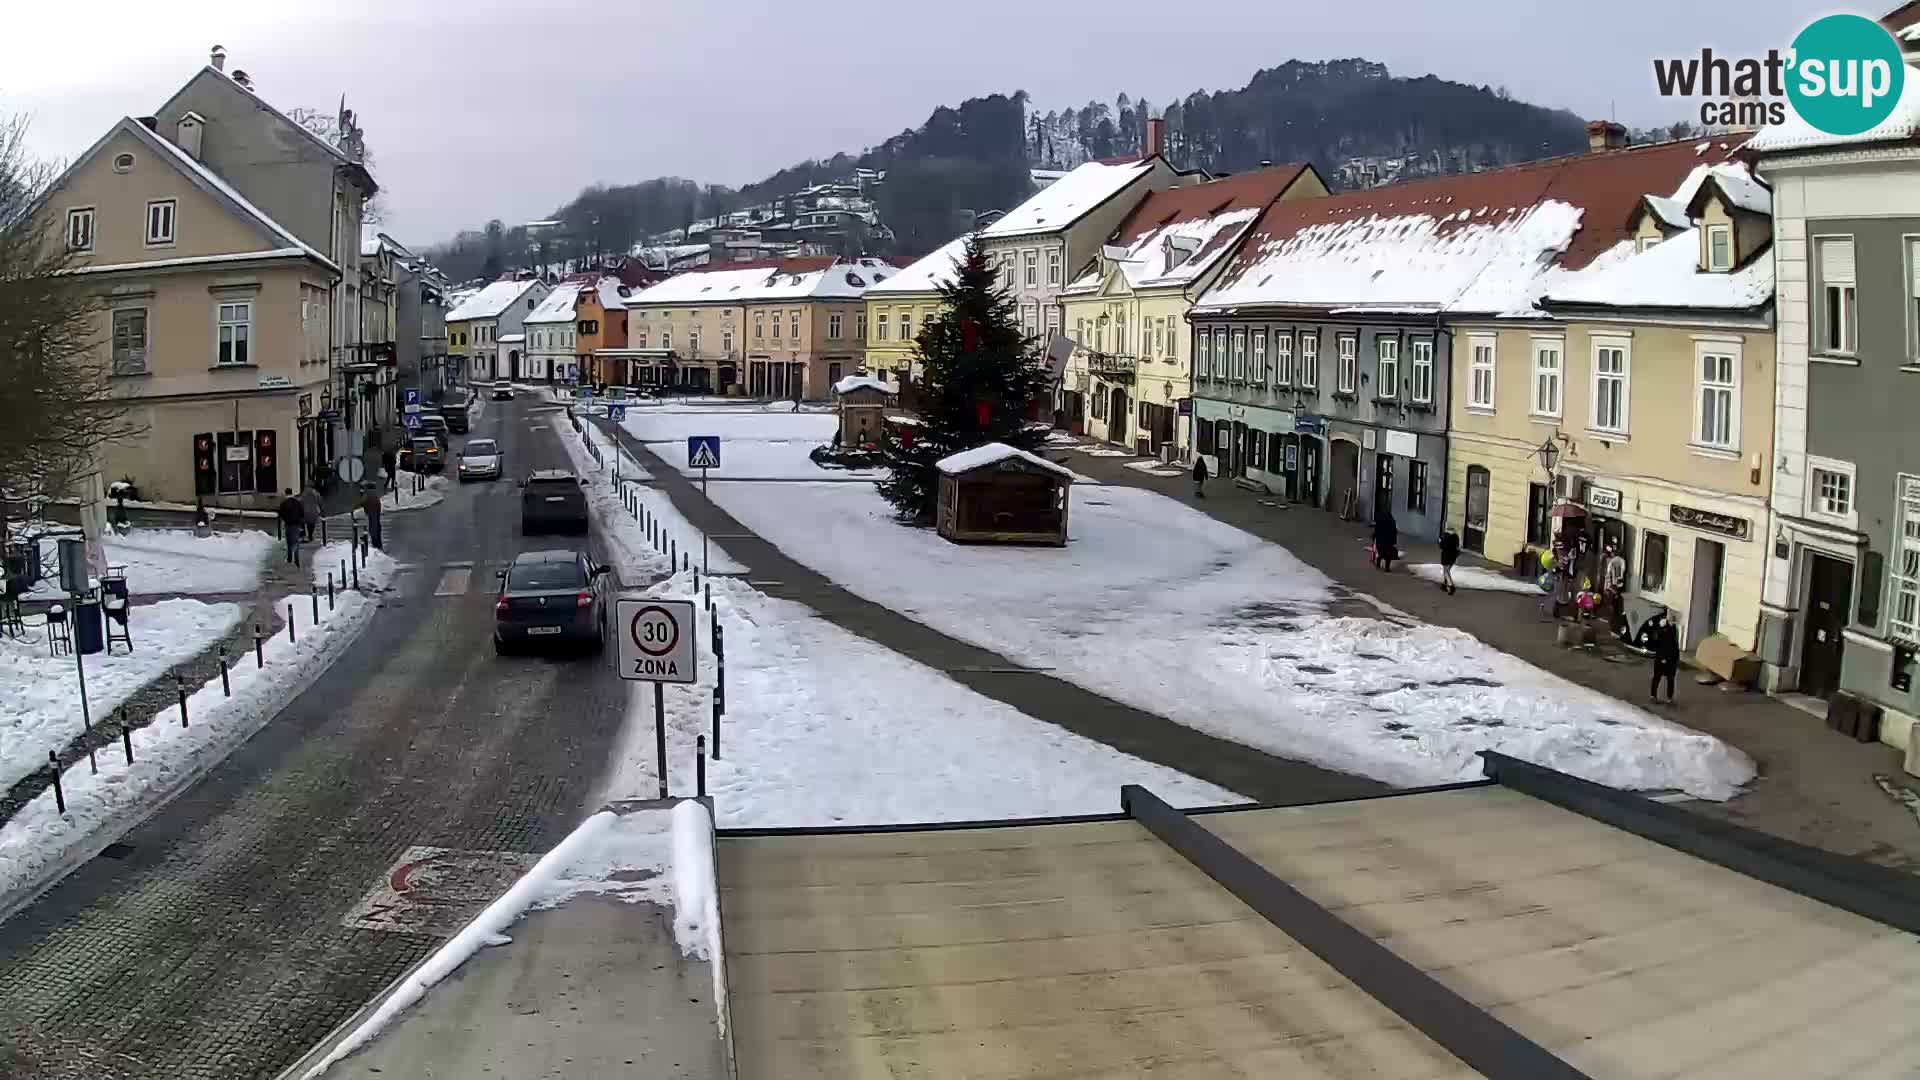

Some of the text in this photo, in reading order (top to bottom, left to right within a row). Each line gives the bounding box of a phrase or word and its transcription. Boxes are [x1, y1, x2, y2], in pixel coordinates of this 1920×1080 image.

[408, 391, 416, 401] P
[643, 621, 668, 643] 30
[633, 658, 679, 676] ZONA
